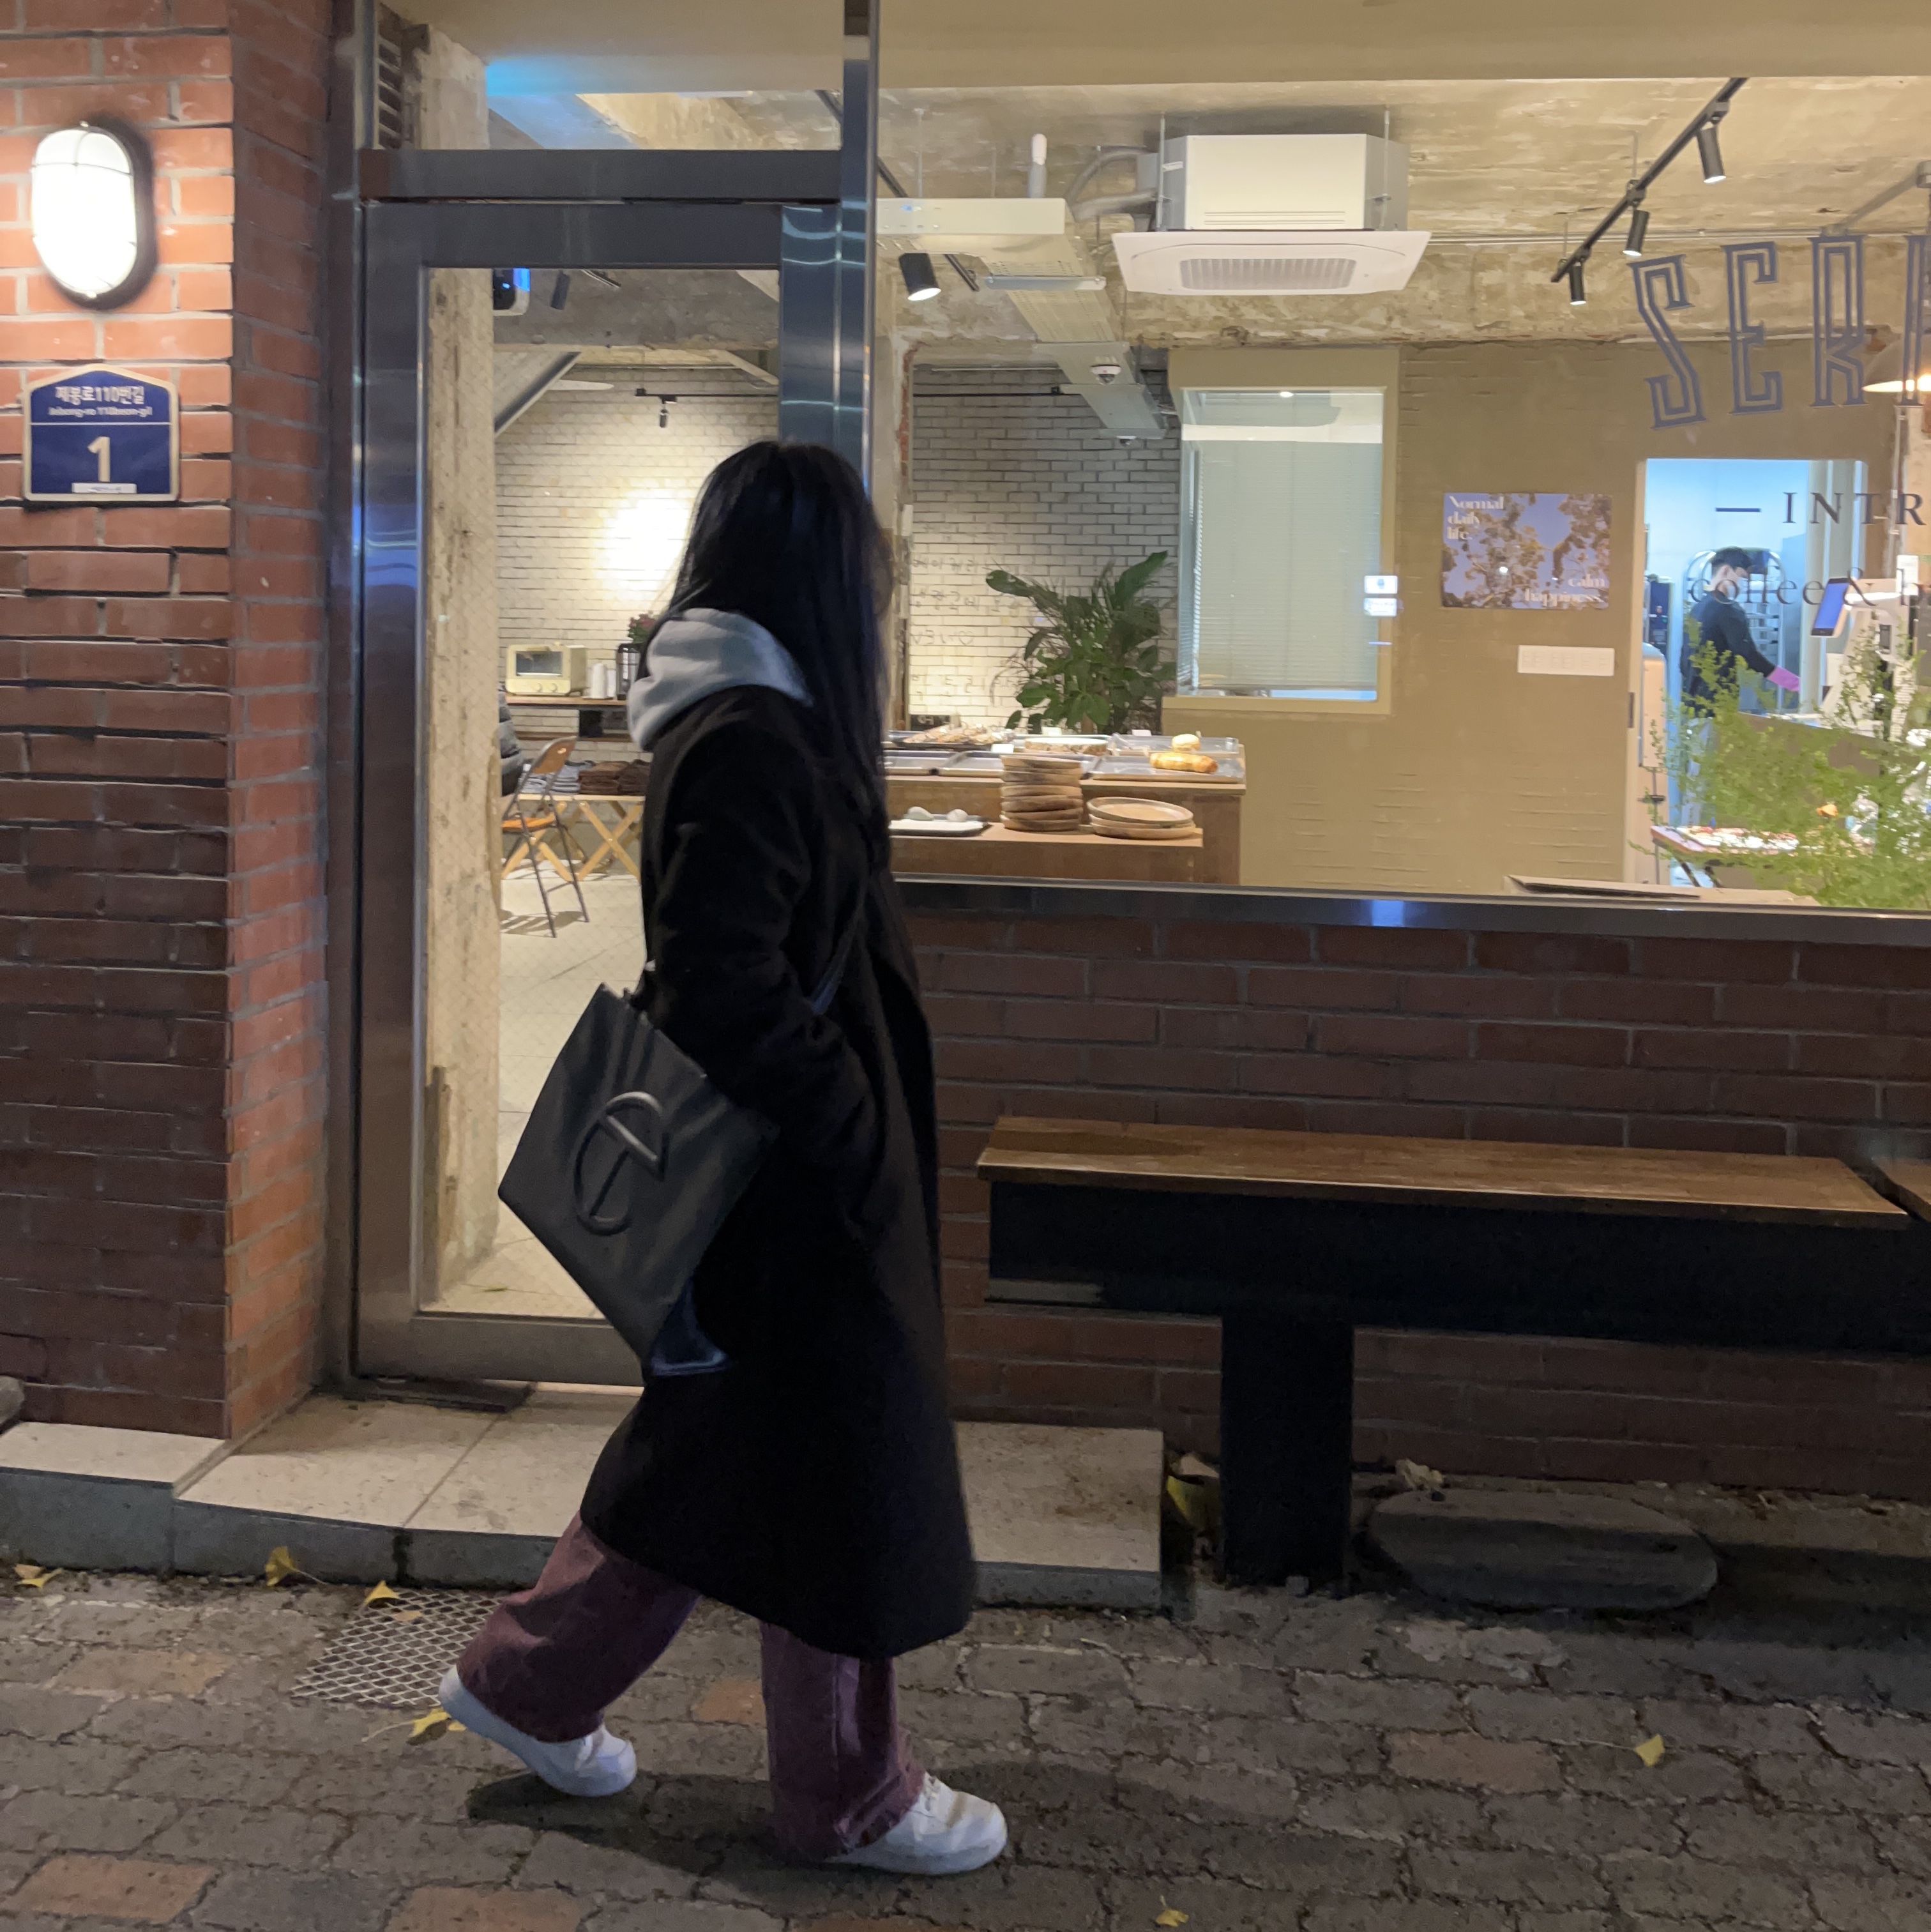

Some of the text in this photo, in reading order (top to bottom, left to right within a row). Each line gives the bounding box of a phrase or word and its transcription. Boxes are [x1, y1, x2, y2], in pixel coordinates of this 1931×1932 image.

[87, 436, 111, 483] 1
[1449, 495, 1504, 510] Normal
[1447, 511, 1481, 528] daily
[1568, 574, 1605, 587] calm
[1690, 565, 1824, 604] coffee
[1843, 567, 1877, 607] &
